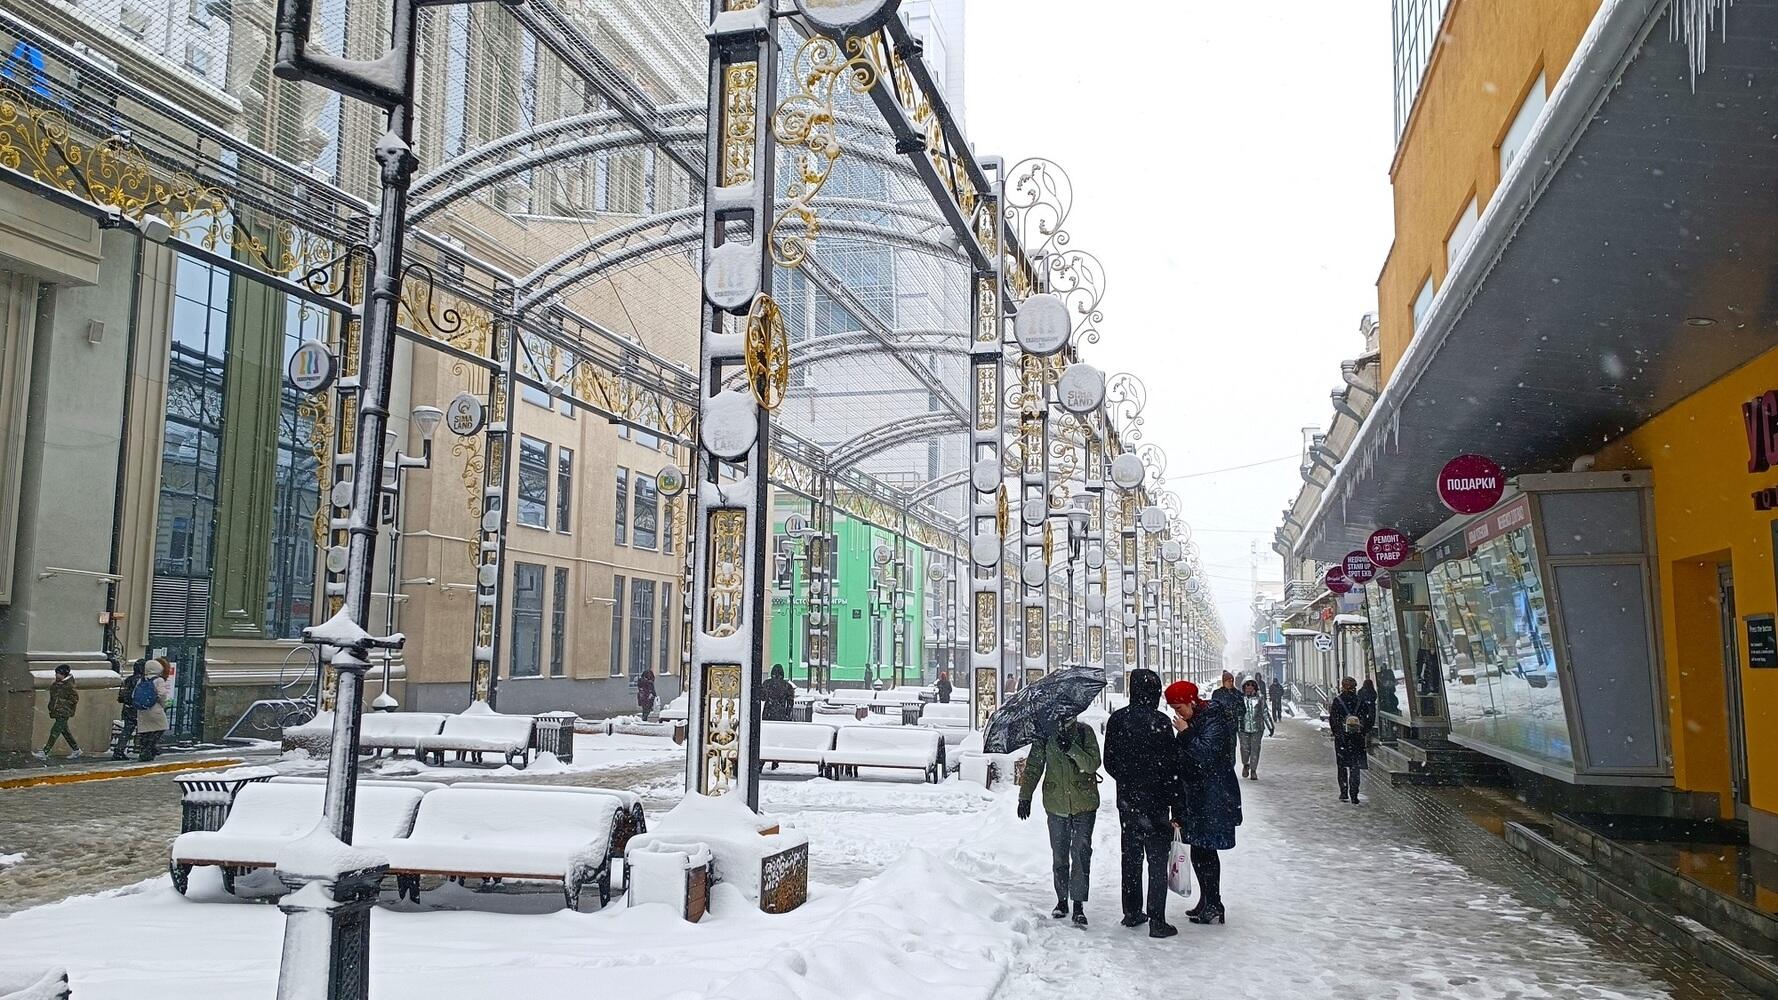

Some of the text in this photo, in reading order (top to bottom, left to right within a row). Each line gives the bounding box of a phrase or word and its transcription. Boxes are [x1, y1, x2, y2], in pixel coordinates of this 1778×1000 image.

[1067, 398, 1094, 407] LAND
[1447, 477, 1496, 491] ПОДАРКИ
[1373, 534, 1400, 544] РЕМОНТ
[1376, 551, 1401, 561] ГРАВЕР
